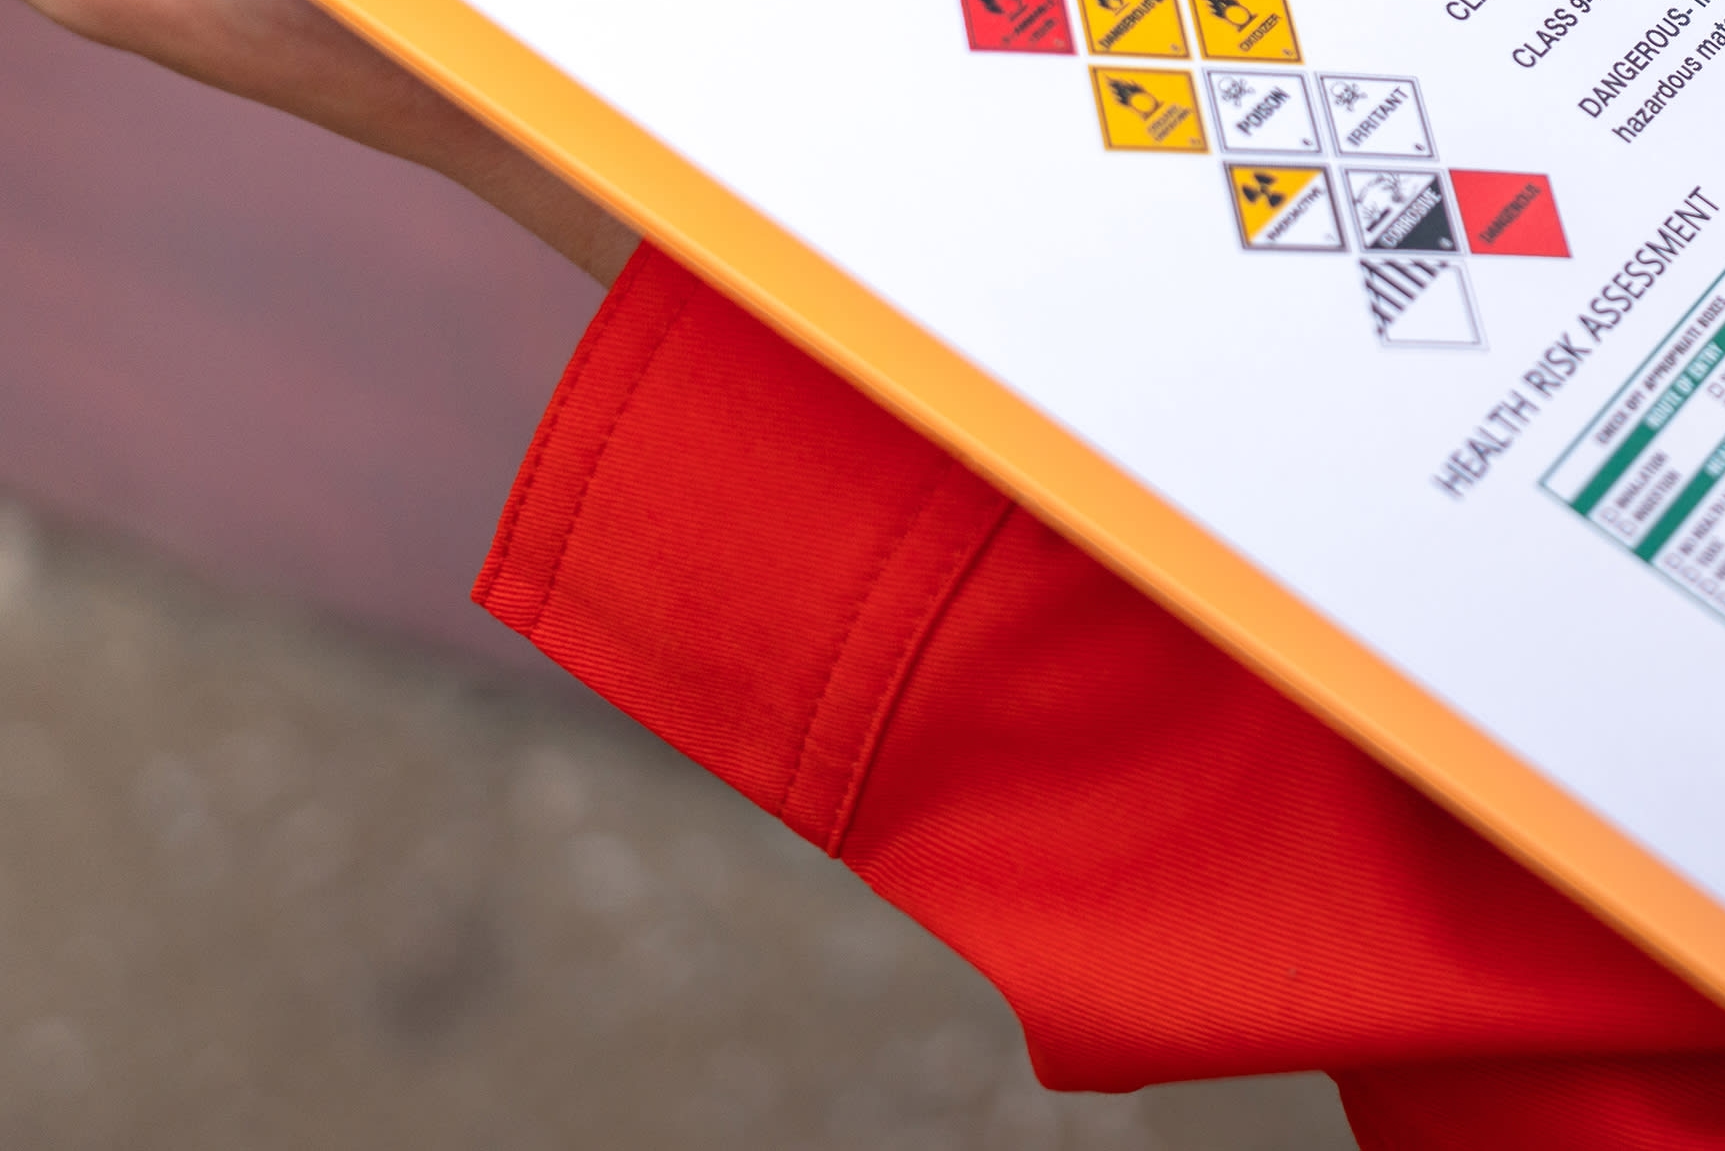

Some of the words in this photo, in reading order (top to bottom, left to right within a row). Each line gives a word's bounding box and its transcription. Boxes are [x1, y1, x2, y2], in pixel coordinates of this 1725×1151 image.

[1239, 13, 1281, 52] OXIDIZER
[1512, 8, 1578, 68] CLASS
[1577, 7, 1694, 118] DANGEROUS-
[1236, 87, 1290, 135] POISON
[1346, 87, 1408, 147] IRRITANT
[1611, 56, 1703, 144] hazardous
[1376, 186, 1450, 248] CORROSIVE
[1435, 390, 1539, 497] HEALTH
[1523, 332, 1592, 397] RISK
[1579, 185, 1720, 342] ASSESSMENT
[1642, 325, 1703, 392] APPROPRIATE
[1643, 389, 1682, 427] ROUTE
[1673, 373, 1693, 394] OF
[1685, 342, 1722, 380] ENTRY
